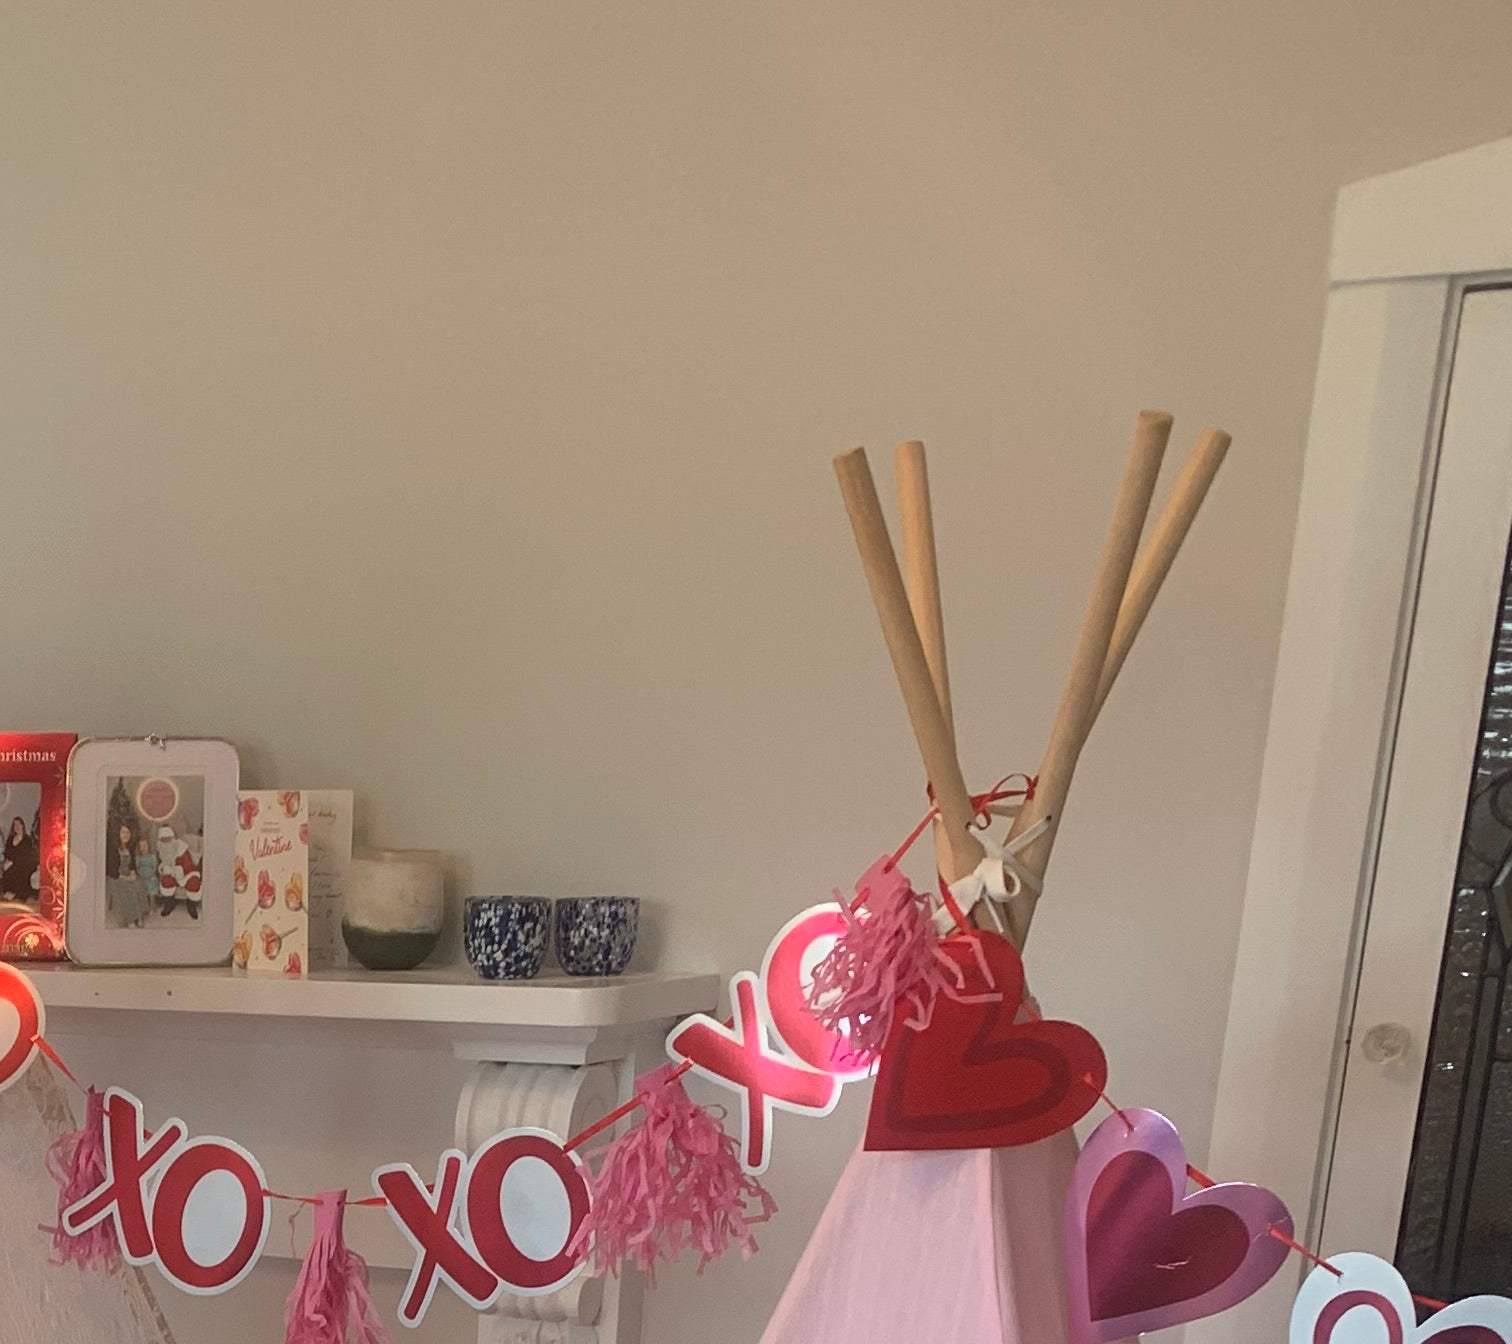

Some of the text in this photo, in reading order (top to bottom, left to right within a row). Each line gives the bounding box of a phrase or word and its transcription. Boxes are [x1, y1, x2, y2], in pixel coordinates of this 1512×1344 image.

[249, 836, 293, 861] Valentine
[67, 1093, 265, 1289] XO
[377, 1134, 591, 1321] XO
